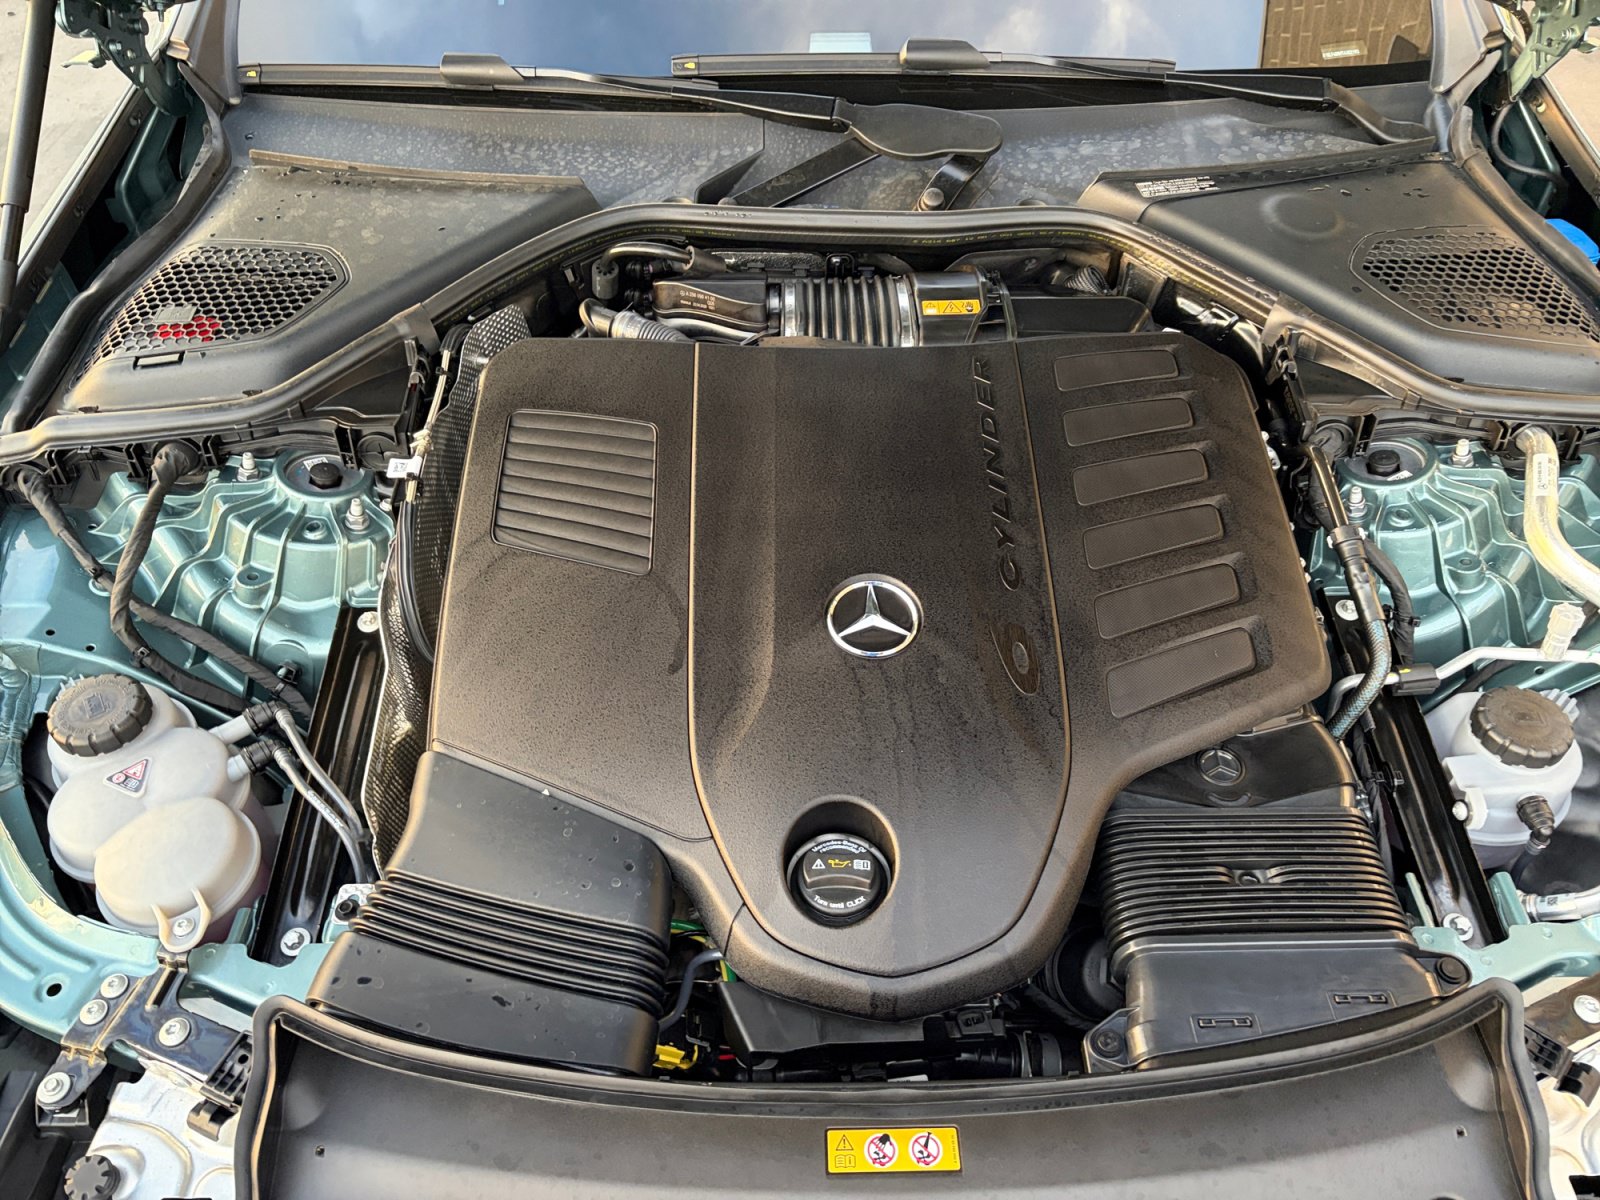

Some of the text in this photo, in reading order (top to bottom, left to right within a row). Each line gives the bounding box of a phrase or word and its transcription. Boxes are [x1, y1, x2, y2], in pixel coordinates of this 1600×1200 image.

[971, 356, 1021, 592] CYLINDER
[811, 840, 858, 852] Mercedes-Benz
[814, 895, 828, 906] Turn
[846, 895, 866, 907] CLICK
